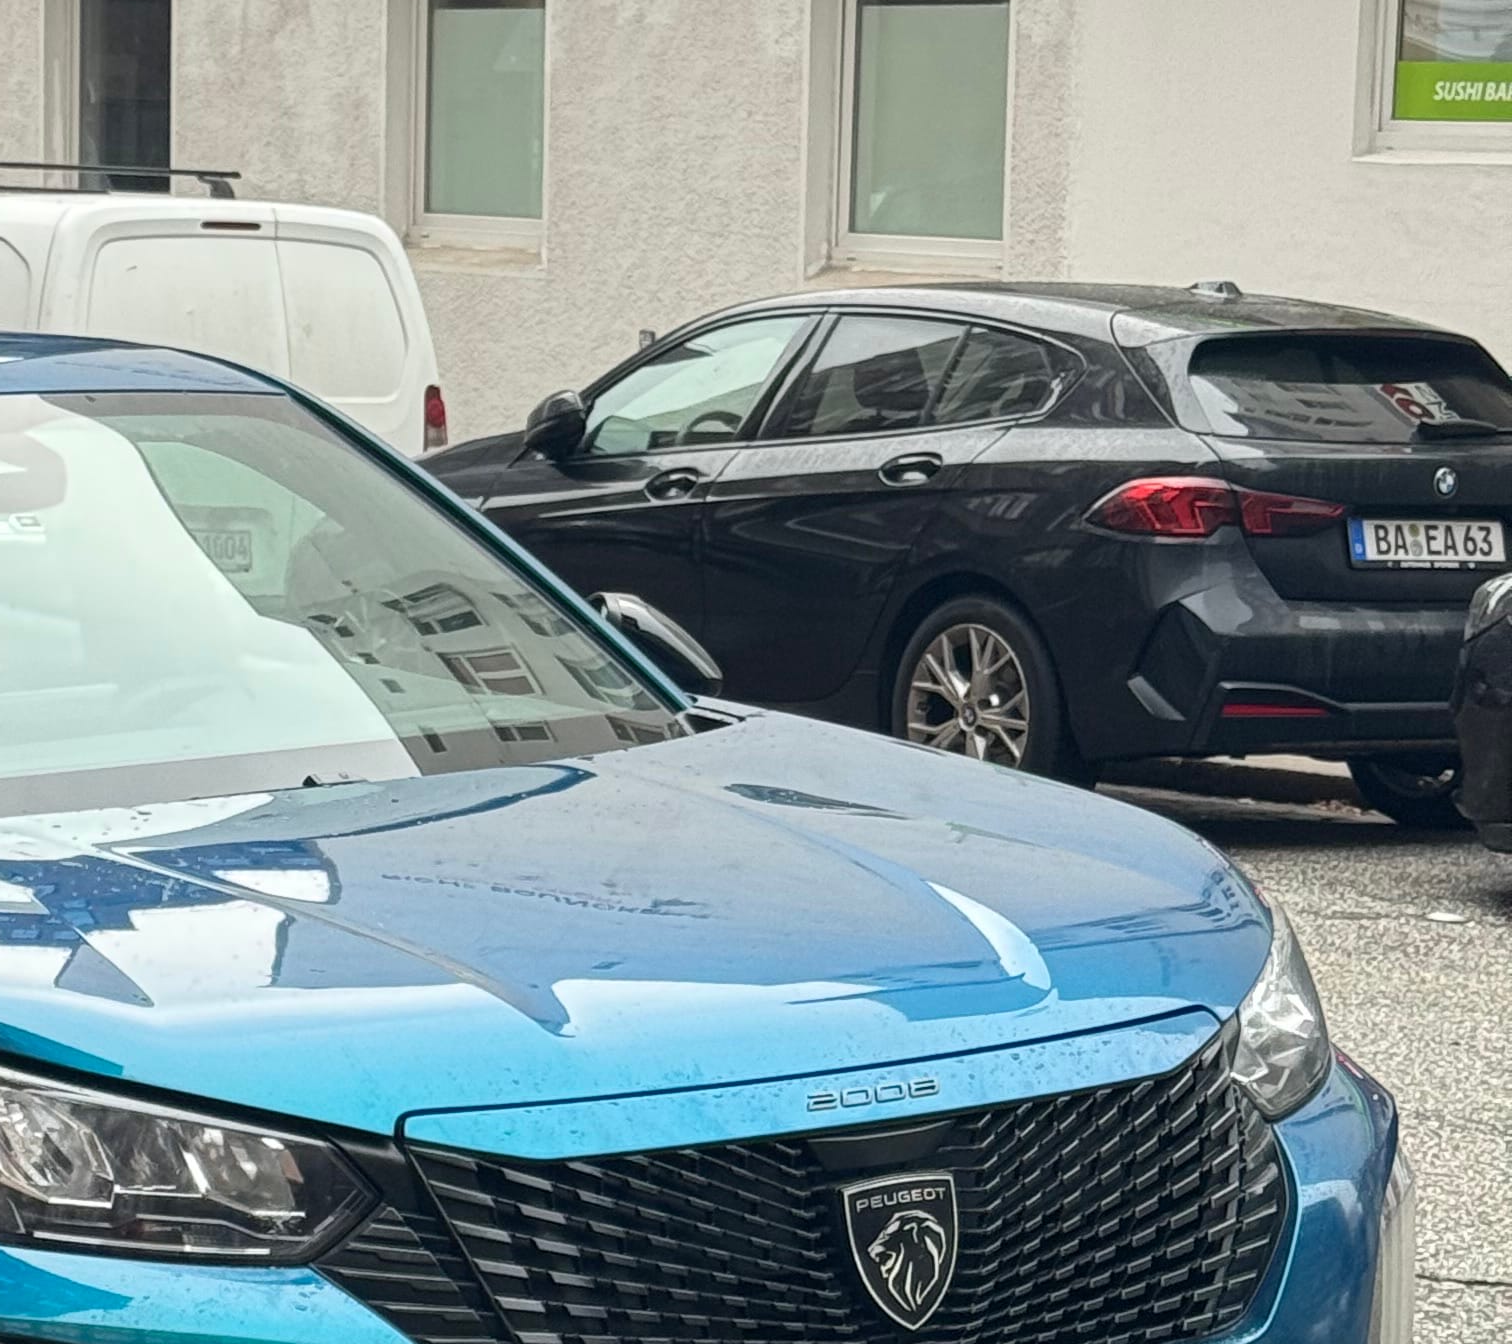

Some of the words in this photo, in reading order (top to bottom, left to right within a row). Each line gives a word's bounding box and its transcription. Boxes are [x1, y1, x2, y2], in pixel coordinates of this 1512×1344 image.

[1433, 80, 1484, 102] SUSHI
[1373, 524, 1409, 556] BA
[806, 1077, 941, 1113] 2008
[855, 1187, 946, 1213] PEUGEOT
